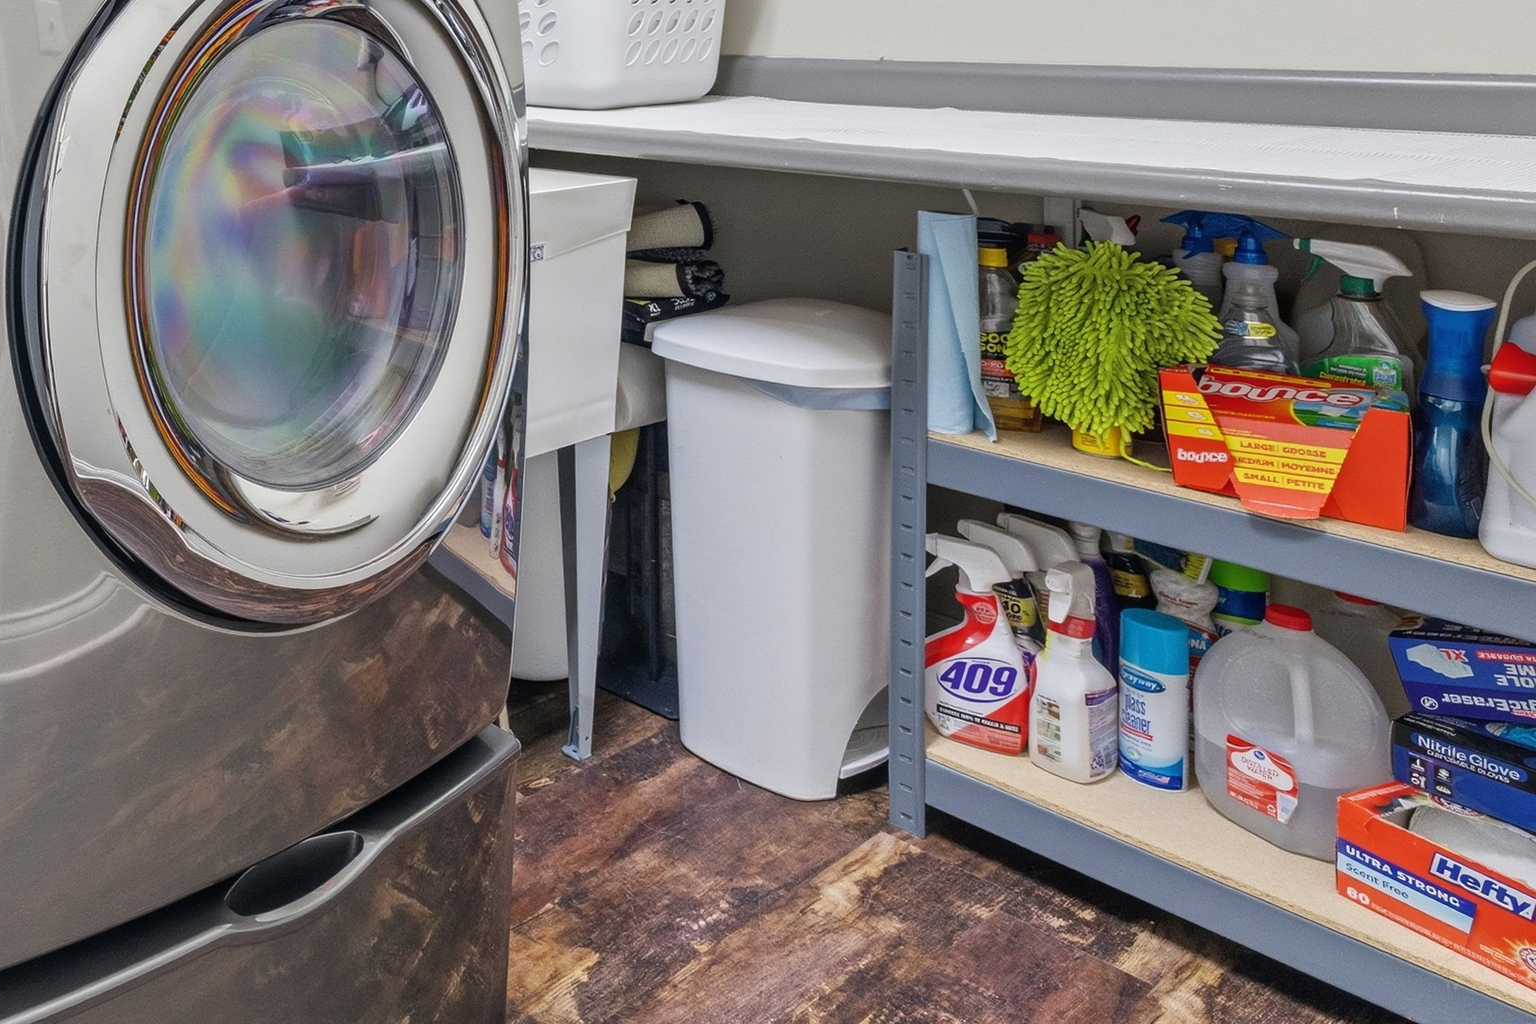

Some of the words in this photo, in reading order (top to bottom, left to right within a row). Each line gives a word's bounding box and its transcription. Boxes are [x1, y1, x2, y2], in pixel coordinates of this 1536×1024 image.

[1198, 375, 1364, 407] bounce
[1176, 448, 1228, 463] bounce
[1239, 440, 1275, 453] LARGE
[1282, 446, 1327, 458] GROSSE
[1243, 473, 1279, 484] SMALL
[1286, 478, 1325, 490] PETITE
[1281, 462, 1336, 476] MOYENNE
[940, 661, 1018, 697] 409
[1418, 735, 1467, 762] Nitrile
[1469, 754, 1520, 781] Glove
[1345, 862, 1379, 887] Scent
[1382, 880, 1409, 899] Free
[1346, 845, 1393, 875] ULTRA
[1397, 871, 1460, 907] STRONG
[1436, 858, 1531, 915] Hefty
